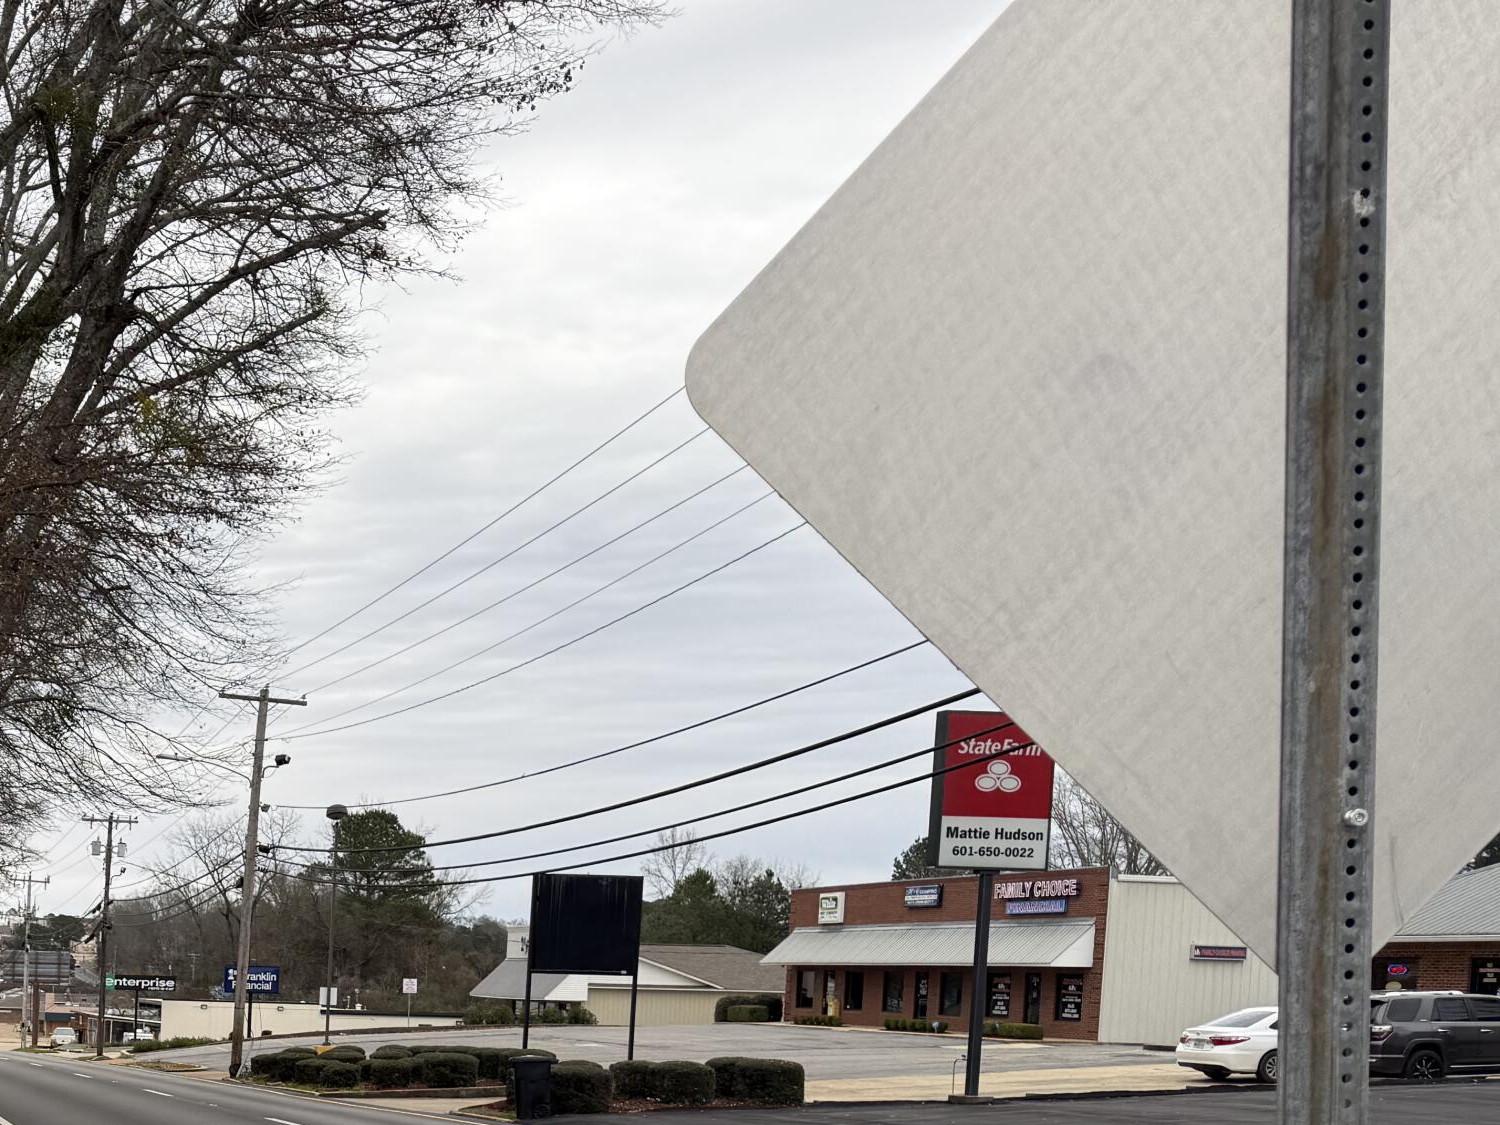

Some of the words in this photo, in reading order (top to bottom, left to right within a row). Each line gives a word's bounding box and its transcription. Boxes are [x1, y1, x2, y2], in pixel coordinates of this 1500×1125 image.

[946, 826, 990, 840] Mattie
[994, 827, 1044, 841] Hudson
[952, 846, 1034, 858] 601-650-0022
[993, 881, 1033, 899] FAMILY
[1033, 879, 1077, 897] CHOICE
[105, 977, 175, 989] enterprise
[246, 972, 277, 982] ranklin
[231, 981, 272, 991] Fancial
